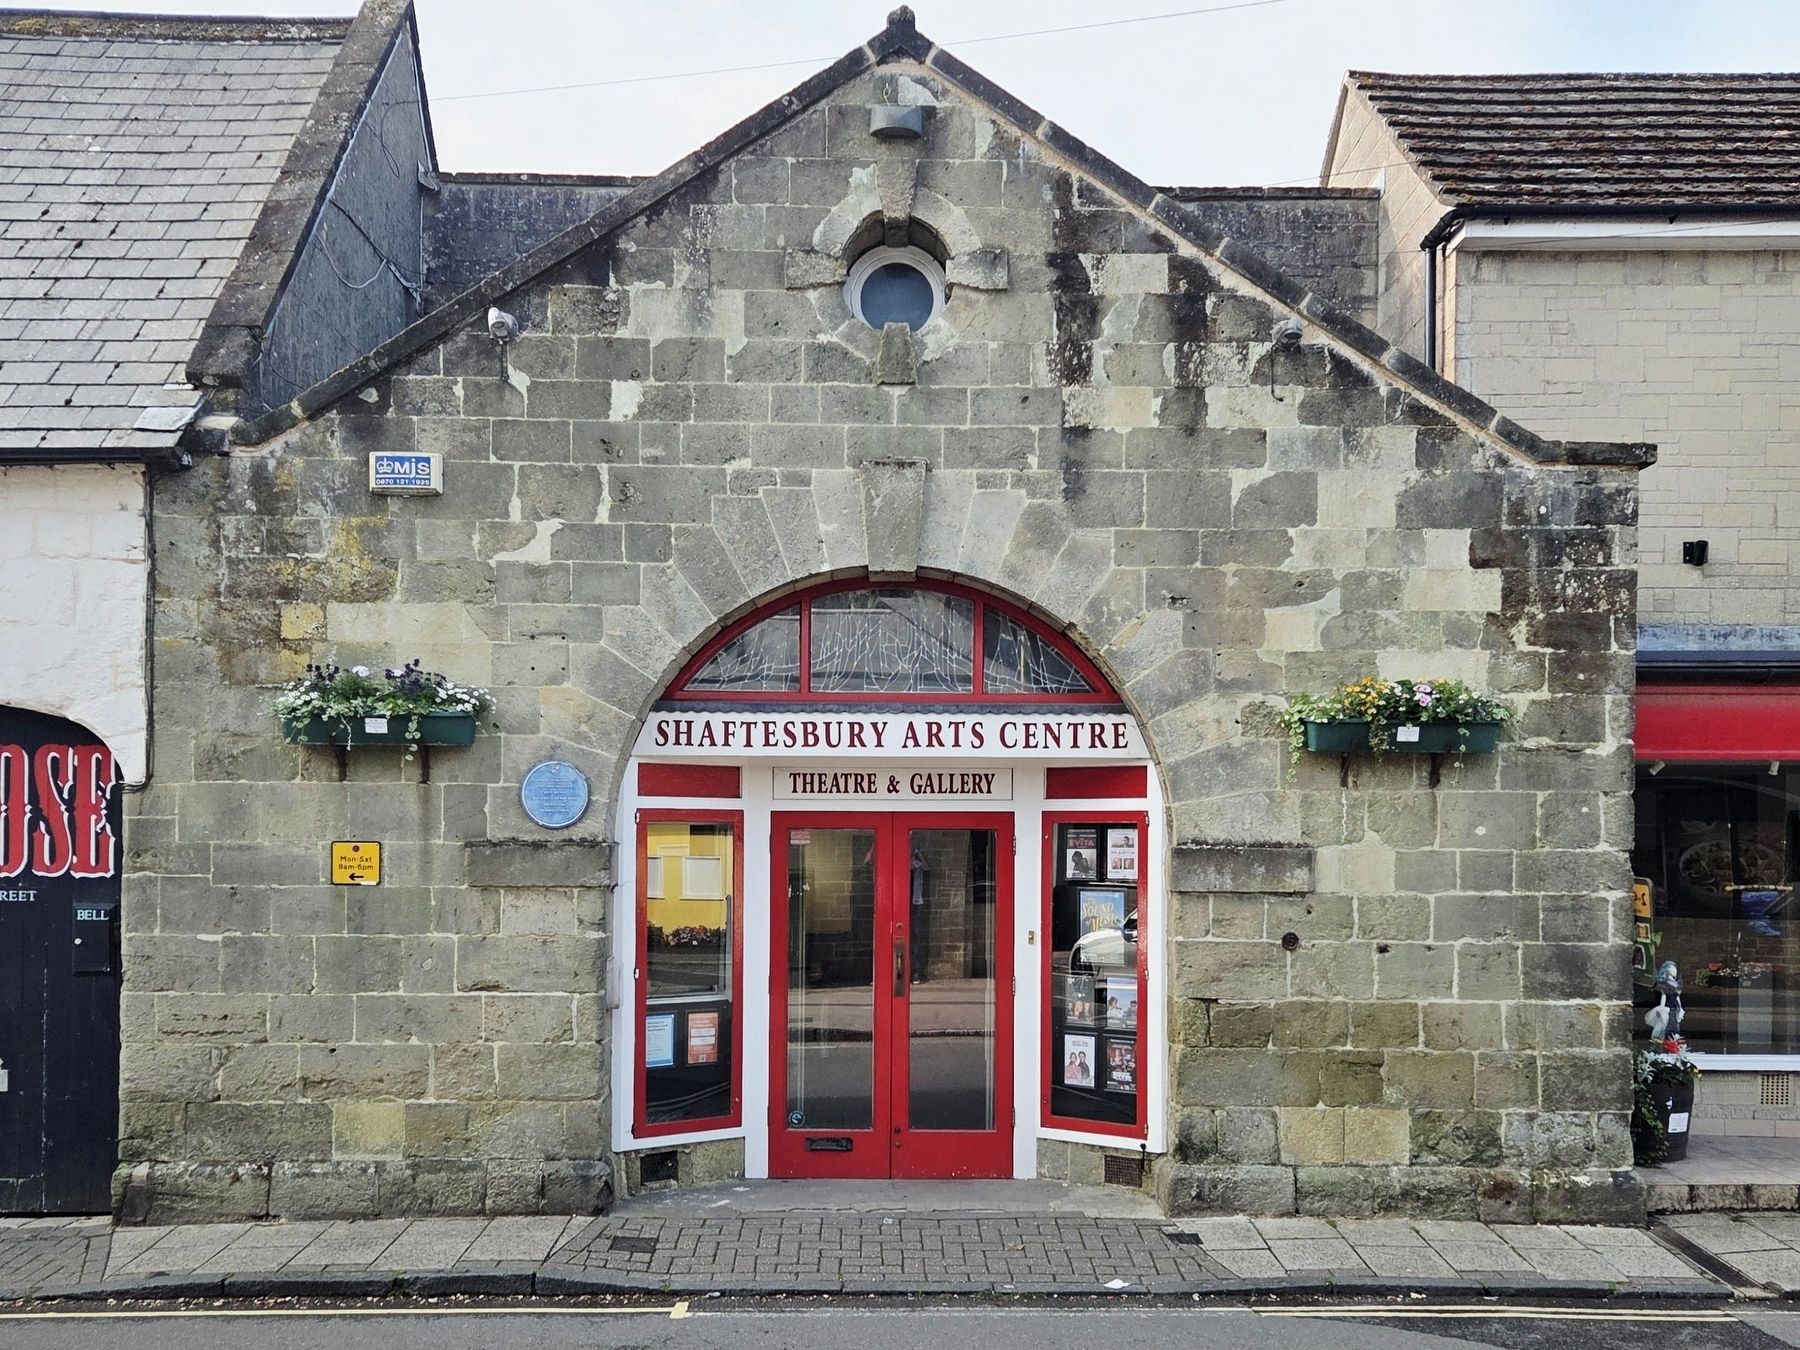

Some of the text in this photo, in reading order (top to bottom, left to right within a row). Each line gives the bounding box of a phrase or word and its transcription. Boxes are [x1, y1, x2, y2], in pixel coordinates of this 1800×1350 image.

[654, 719, 1129, 749] SHAFTESBURY ARTS CENTRE
[788, 772, 996, 795] THEATRE & GALLERY
[76, 909, 110, 921] BELL
